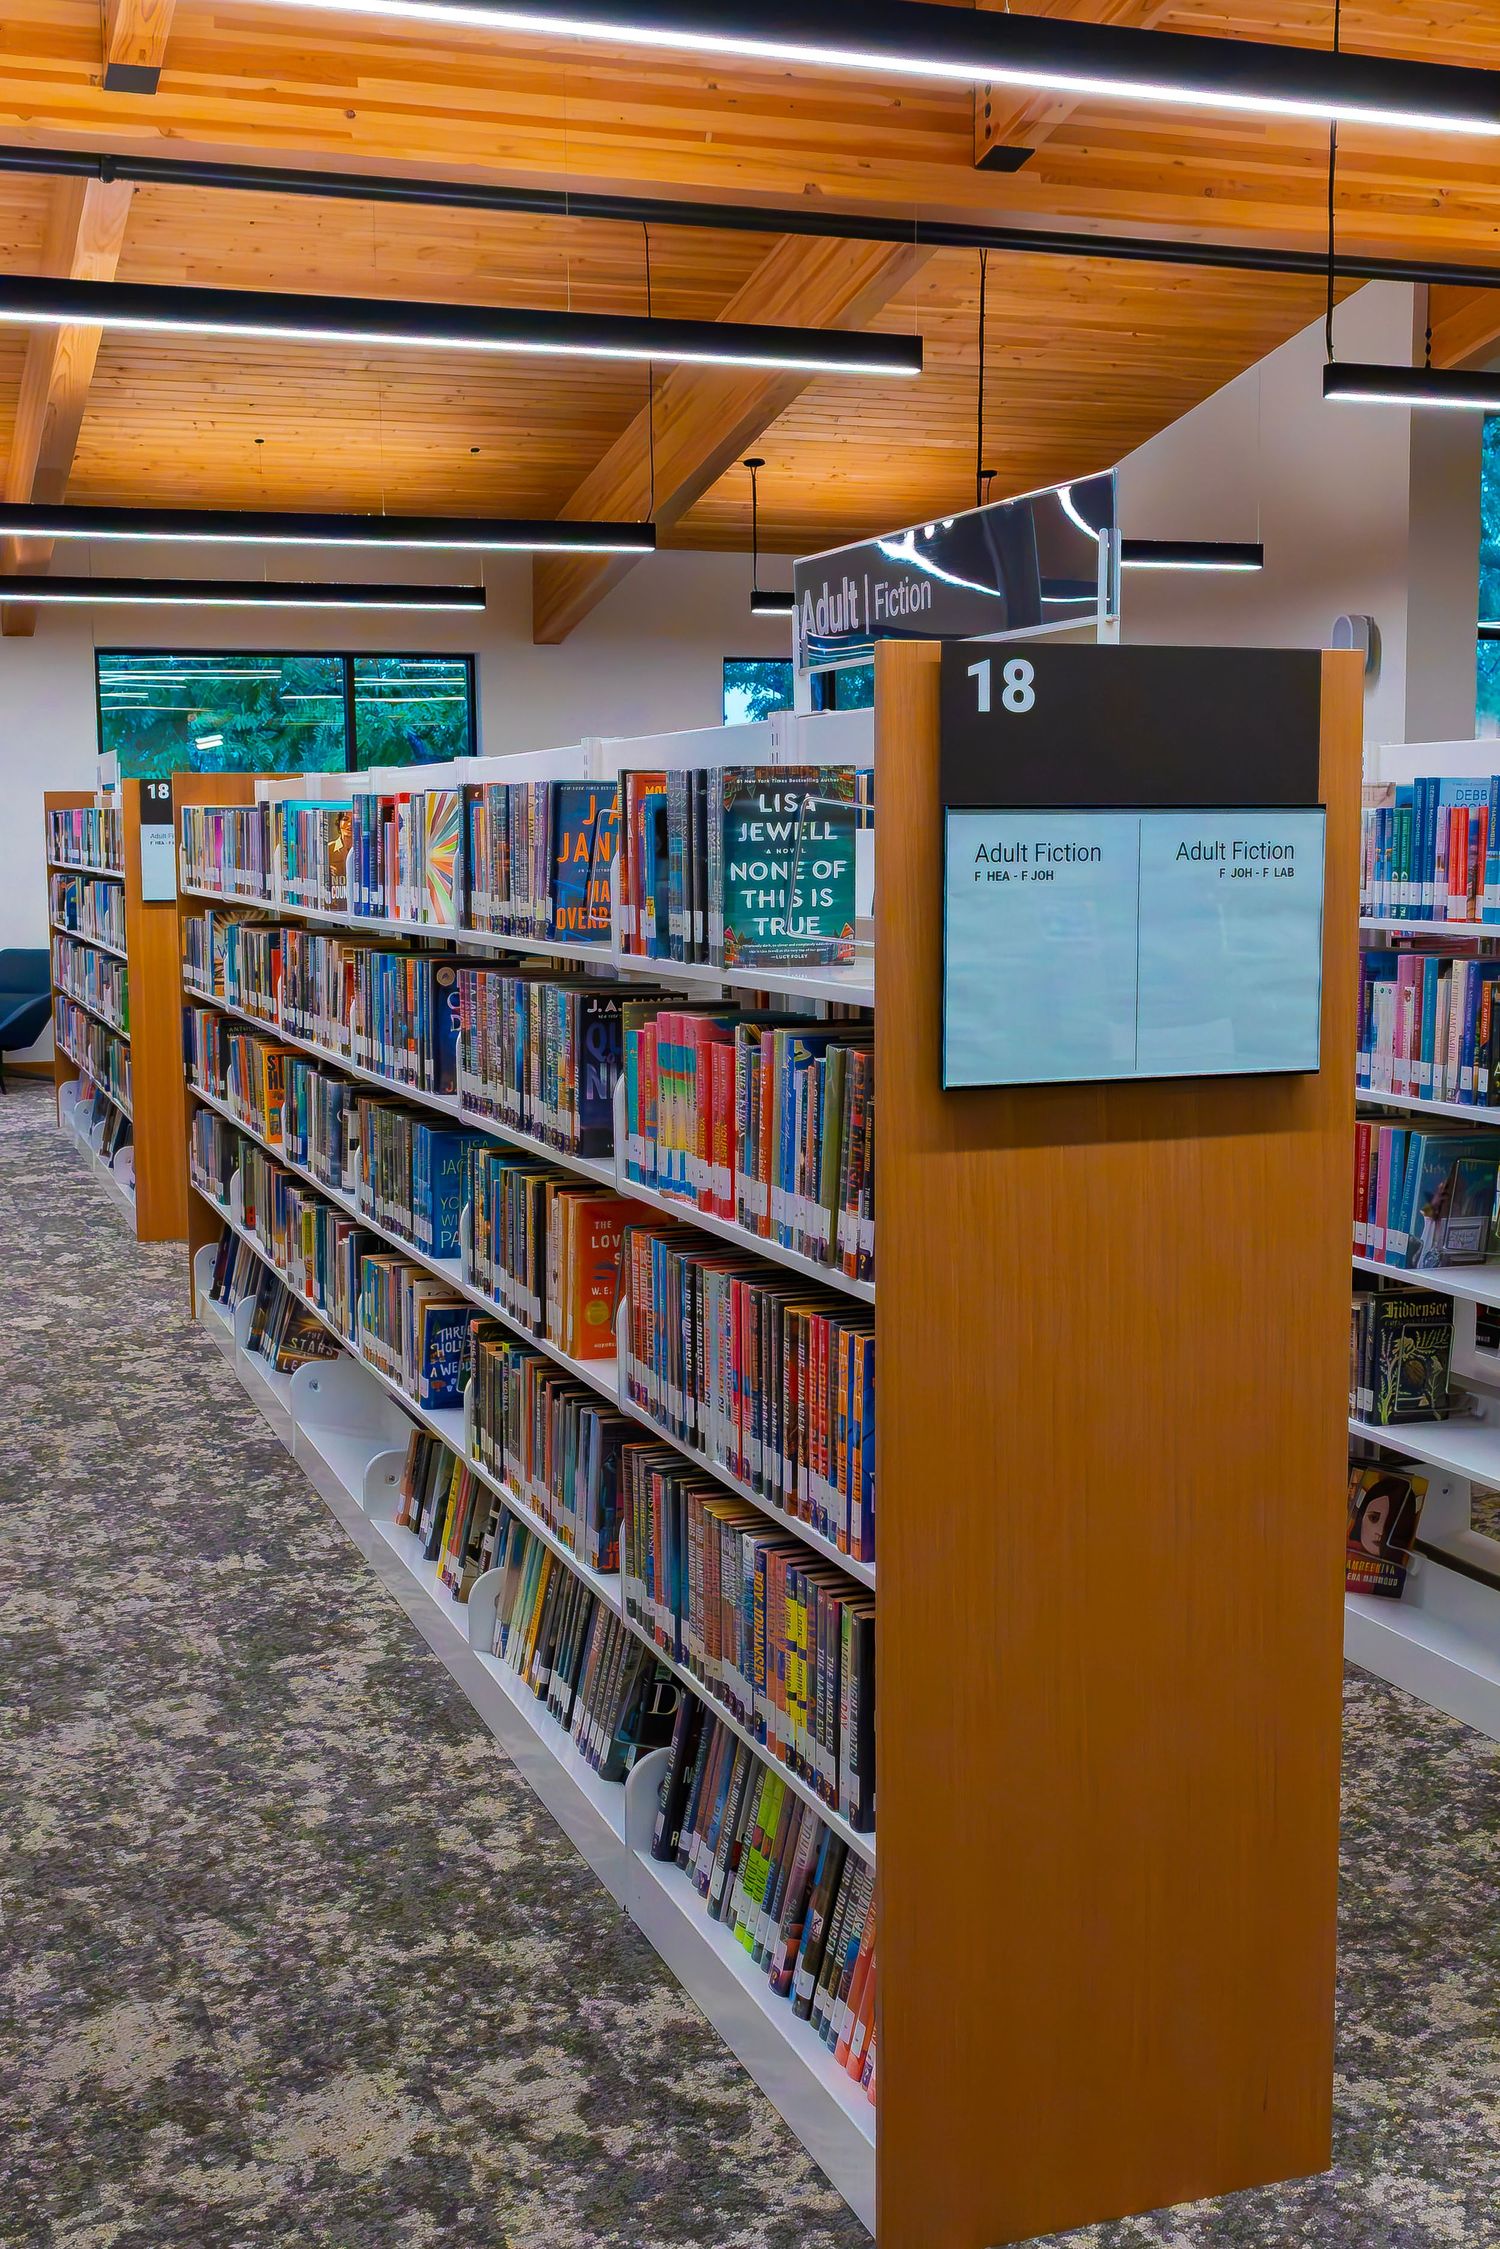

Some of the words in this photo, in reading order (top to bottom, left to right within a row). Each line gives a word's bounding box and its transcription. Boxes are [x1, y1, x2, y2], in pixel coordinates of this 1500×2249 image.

[800, 575, 860, 640] Adult
[874, 579, 932, 618] Fiction
[967, 658, 1035, 712] 18
[147, 783, 169, 799] 18
[759, 793, 816, 813] LISA
[738, 821, 838, 842] JEWELL
[557, 831, 618, 864] JAN
[974, 842, 1027, 863] Adult
[1034, 842, 1101, 863] Fiction
[1176, 841, 1226, 862] Adult
[1232, 840, 1294, 862] Fiction
[730, 861, 805, 881] NONE
[811, 860, 848, 879] OF
[974, 871, 980, 881] F
[987, 870, 1010, 881] HEA
[1021, 870, 1027, 881] F
[1031, 869, 1054, 881] JOH
[1219, 868, 1225, 879] F
[1231, 868, 1253, 879] JOH
[1262, 868, 1269, 878] F
[1273, 867, 1295, 878] LAB
[740, 889, 804, 909] THIS
[811, 888, 833, 907] IS
[753, 916, 821, 936] TRUE
[587, 999, 622, 1013] J.A.
[738, 1099, 747, 1138] BIRDS
[720, 1123, 728, 1160] YOURS
[594, 1221, 613, 1229] THE
[591, 1287, 612, 1295] W.E.
[1381, 1301, 1448, 1319] Hiddensee
[647, 1509, 655, 1557] JOHANSEN
[753, 1570, 764, 1602] ROY
[1347, 1573, 1361, 1581] ENA
[753, 1602, 764, 1685] JOHANSEN
[817, 1647, 825, 1672] THE
[826, 1655, 834, 1679] THE
[841, 1637, 849, 1681] NIGHT
[817, 1674, 825, 1716] NAKED
[826, 1681, 835, 1725] NAKED
[849, 1674, 858, 1717] NIGHT
[817, 1718, 825, 1744] EYE
[840, 1704, 849, 1731] DAY
[667, 1735, 678, 1770] NIGHT
[826, 1727, 834, 1752] EYE
[849, 1718, 859, 1767] WATCH
[735, 1762, 745, 1785] IRIS
[755, 1775, 765, 1796] IRIS
[661, 1771, 672, 1808] WATCH
[724, 1784, 741, 1836] JOHANSEN
[744, 1796, 760, 1848] JOHANSEN
[842, 1858, 855, 1886] IRIS
[851, 1868, 864, 1898] IRIS
[826, 1888, 846, 1956] JOHANSEN
[835, 1898, 856, 1967] JOHANSEN
